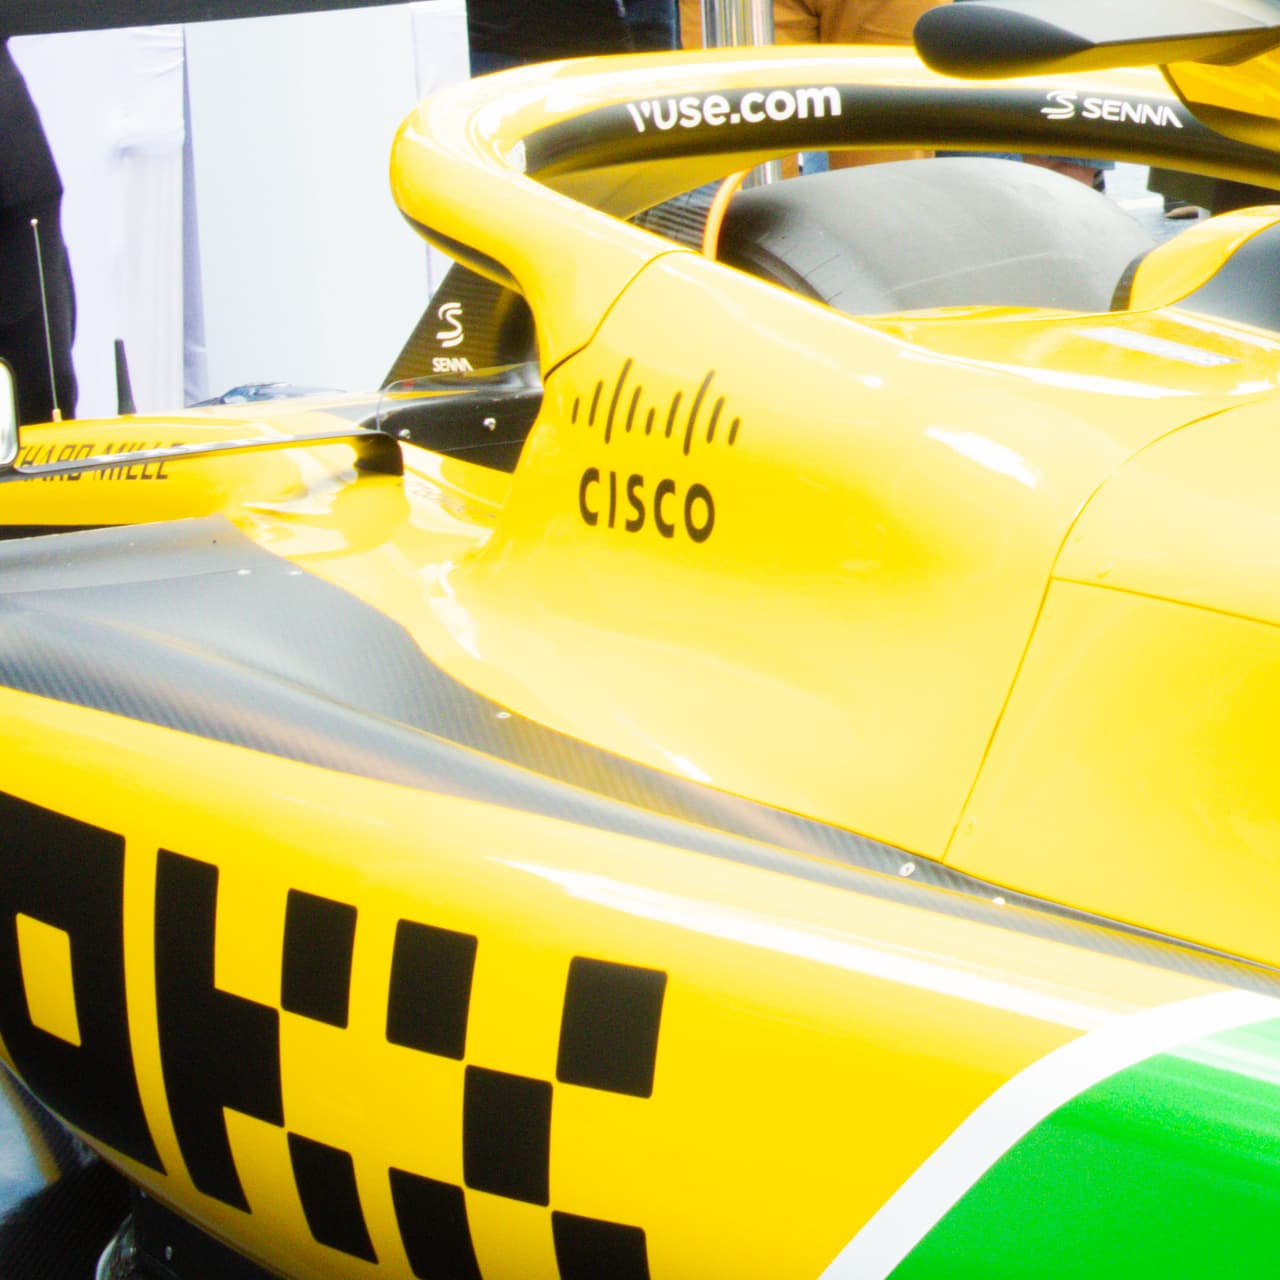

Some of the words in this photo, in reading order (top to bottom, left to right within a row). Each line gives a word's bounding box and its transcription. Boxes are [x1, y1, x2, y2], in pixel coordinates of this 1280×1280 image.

[1081, 98, 1184, 129] SENNA
[432, 357, 474, 373] SENNA
[579, 467, 716, 544] CISCO
